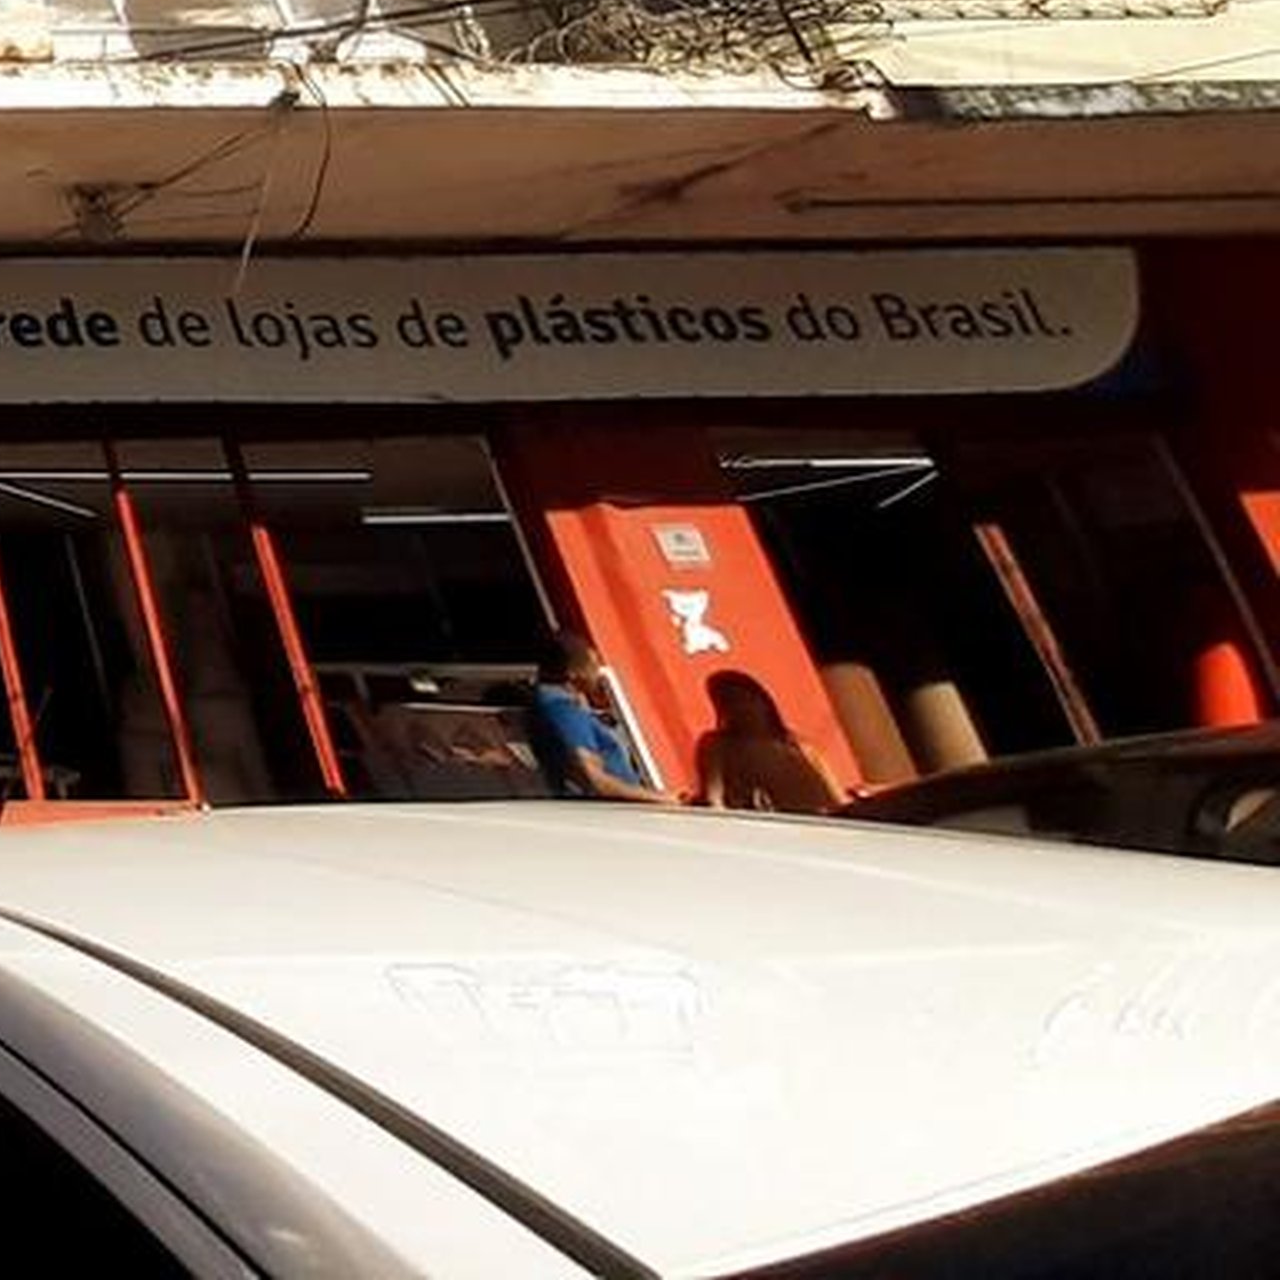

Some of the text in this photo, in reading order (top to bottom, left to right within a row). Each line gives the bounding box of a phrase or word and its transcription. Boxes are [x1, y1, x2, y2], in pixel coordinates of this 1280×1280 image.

[140, 298, 210, 347] de
[226, 298, 378, 360] lojas
[397, 300, 468, 349] de
[485, 295, 773, 360] plásticos
[791, 293, 861, 342] do
[873, 288, 1072, 341] Brasil.
